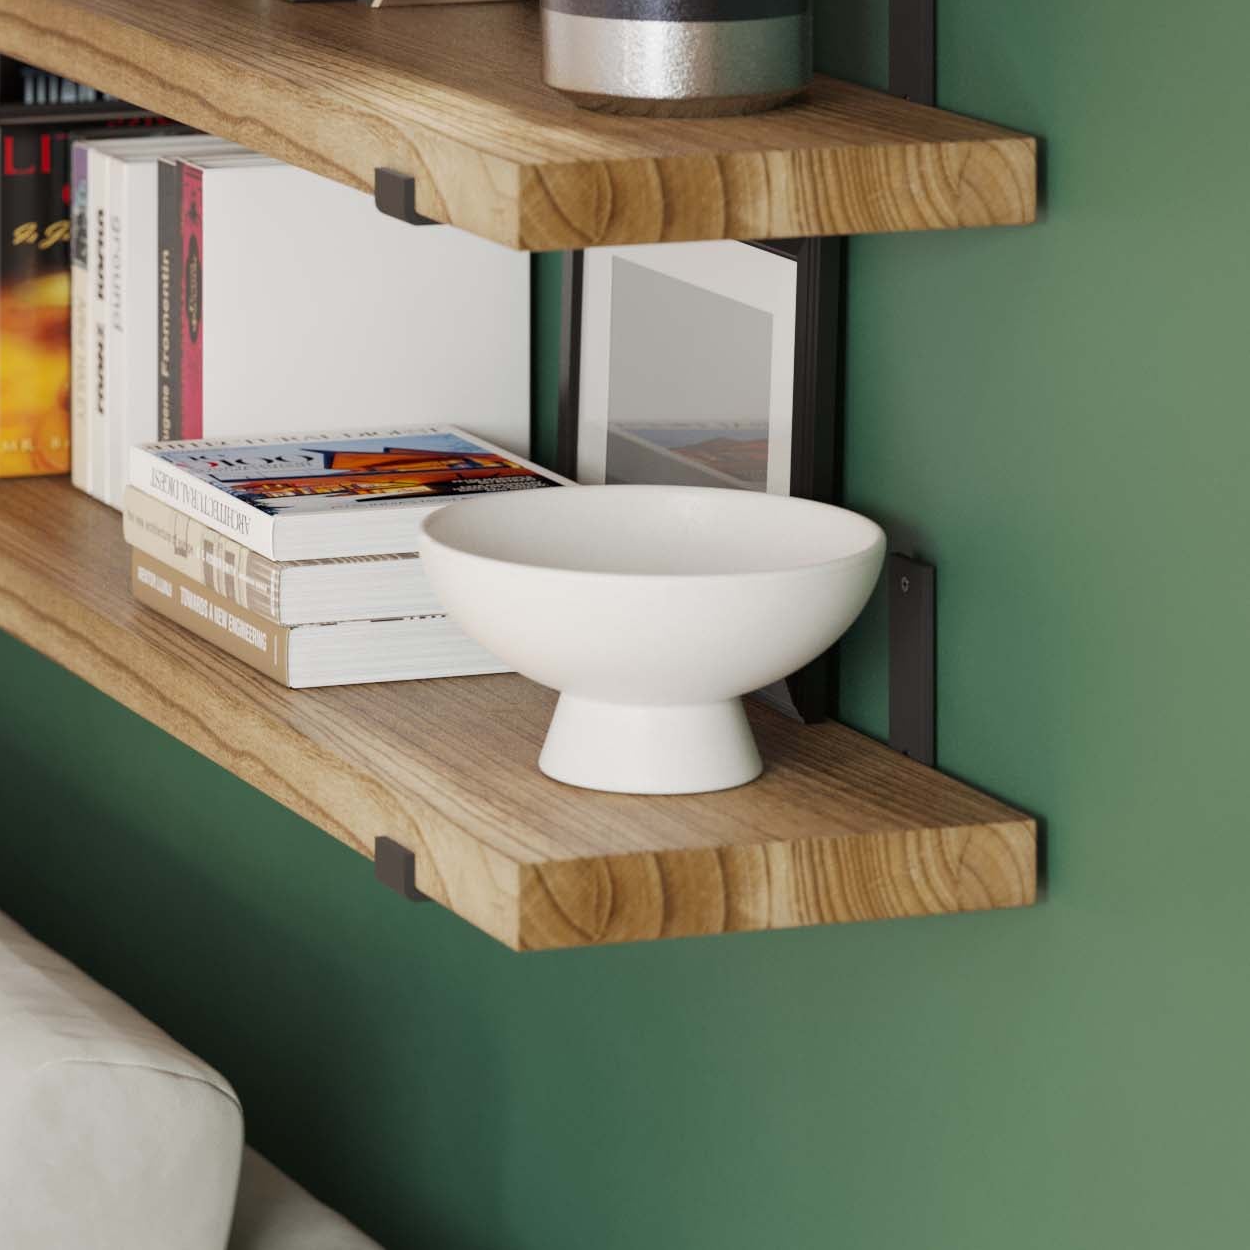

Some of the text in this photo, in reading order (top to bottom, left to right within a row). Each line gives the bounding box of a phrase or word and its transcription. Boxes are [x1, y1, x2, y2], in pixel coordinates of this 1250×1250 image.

[159, 248, 171, 440] ugene Fromentin
[149, 465, 251, 536] ARCHITECTURAL DIGEST
[180, 585, 267, 652] TOWARDS A NEW ENGINEERING
